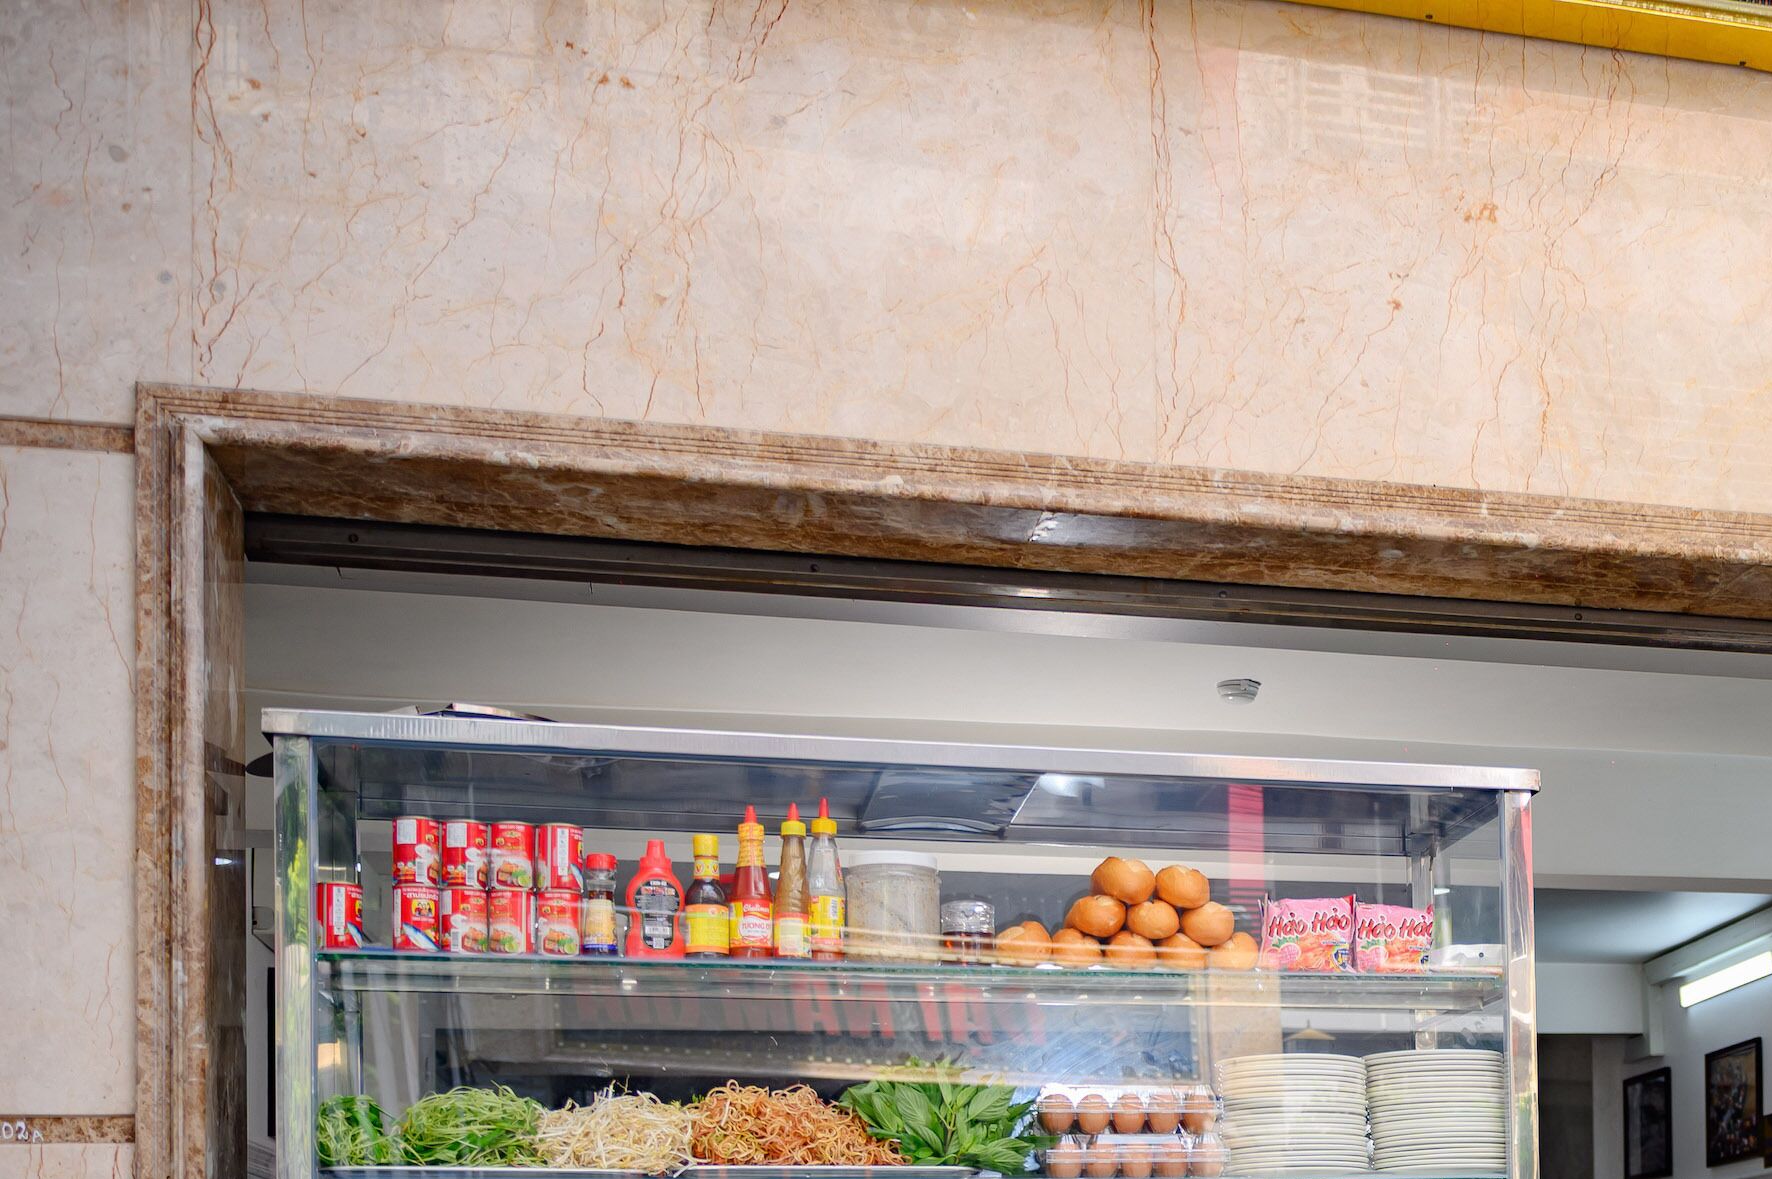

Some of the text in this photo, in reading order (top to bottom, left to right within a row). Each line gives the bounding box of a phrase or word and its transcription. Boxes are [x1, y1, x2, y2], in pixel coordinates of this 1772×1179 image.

[1268, 907, 1352, 938] Hảo Hảo
[1357, 915, 1397, 940] Hảo
